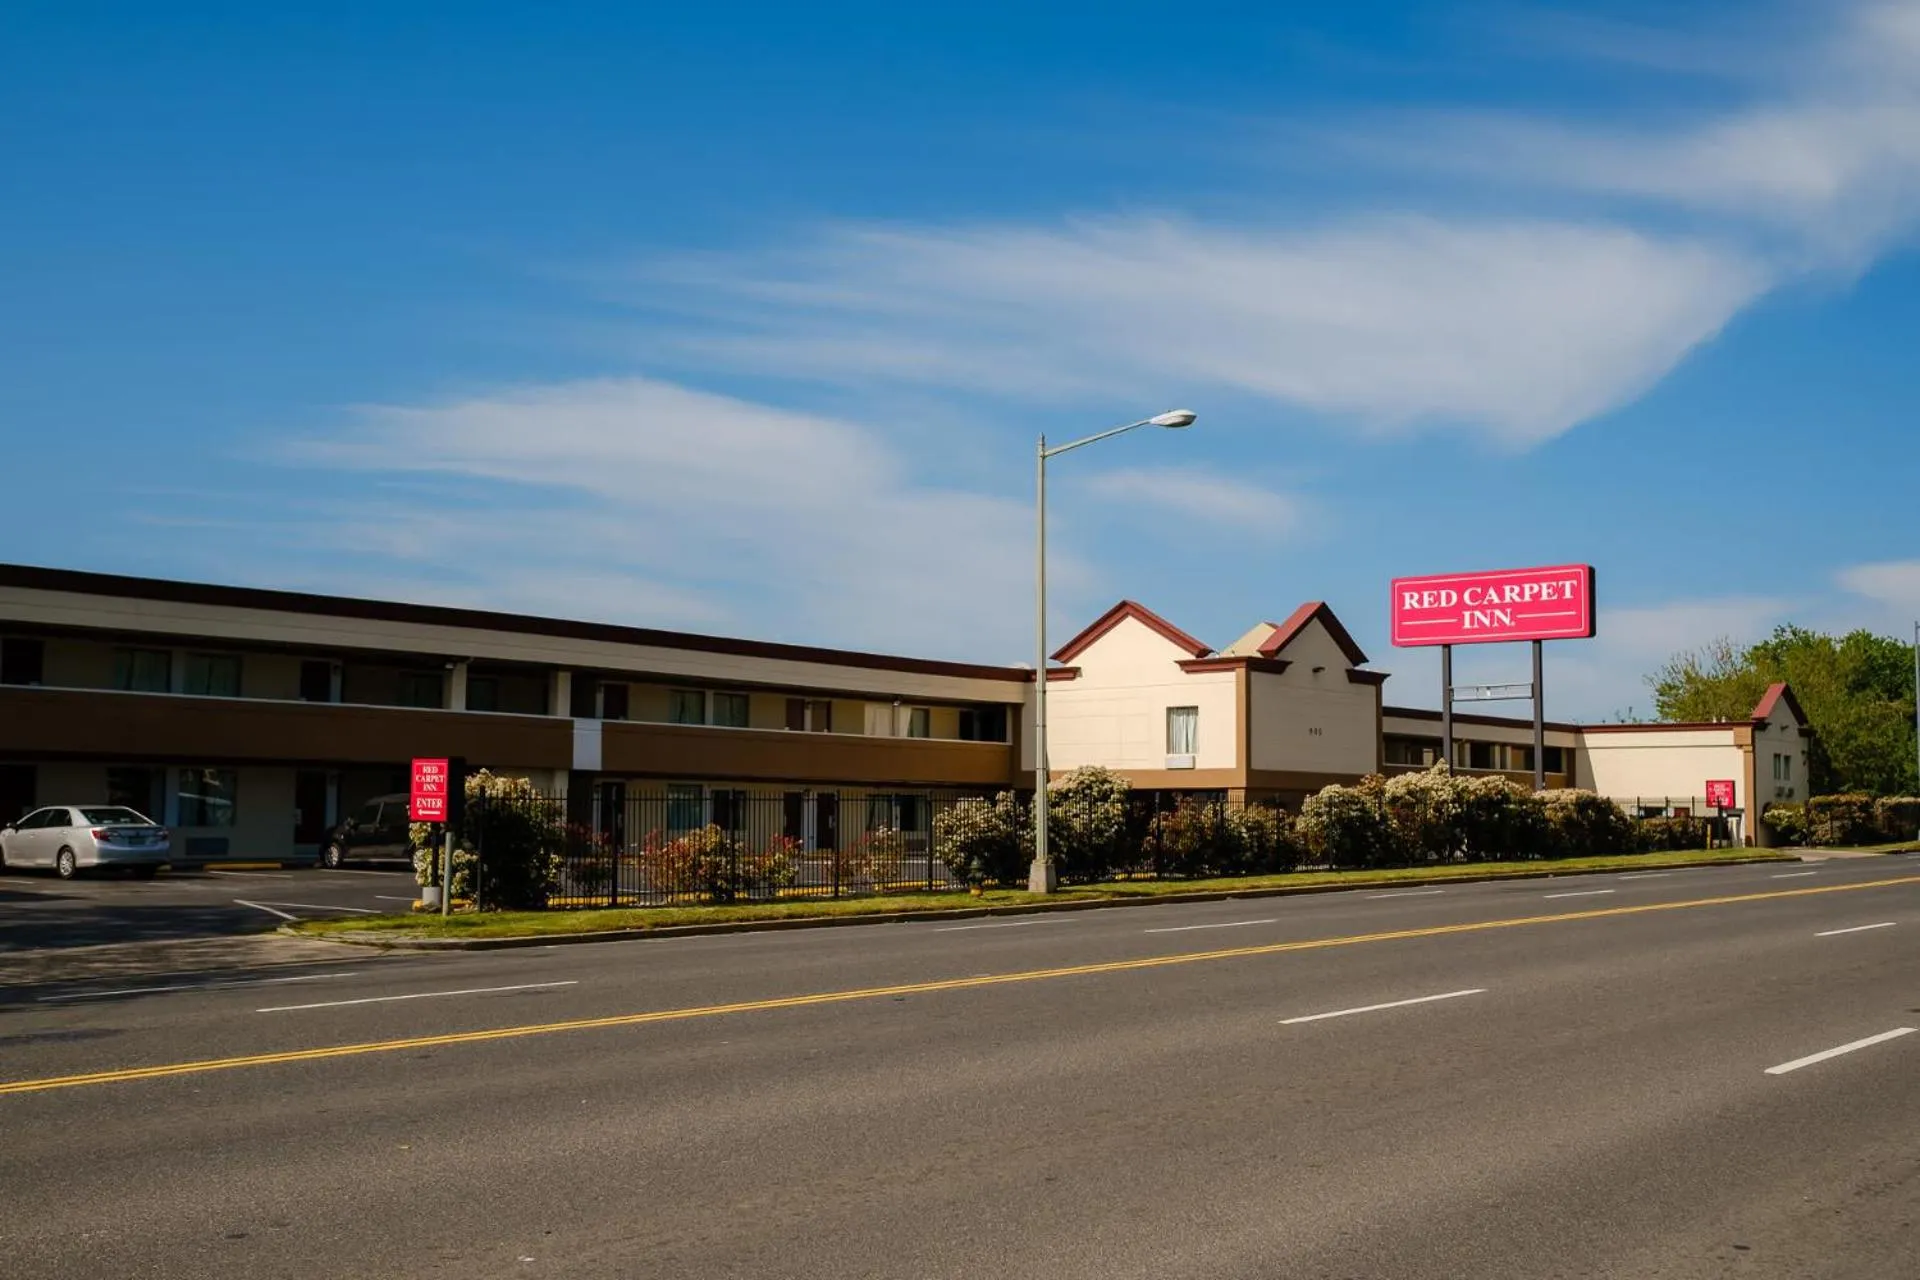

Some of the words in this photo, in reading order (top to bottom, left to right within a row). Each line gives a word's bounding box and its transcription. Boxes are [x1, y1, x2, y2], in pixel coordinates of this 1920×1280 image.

[1402, 589, 1458, 610] RED
[1463, 580, 1578, 606] CARPET
[423, 766, 439, 774] RED
[415, 774, 444, 783] CARPET
[423, 783, 437, 791] INN
[416, 797, 443, 808] ENTER
